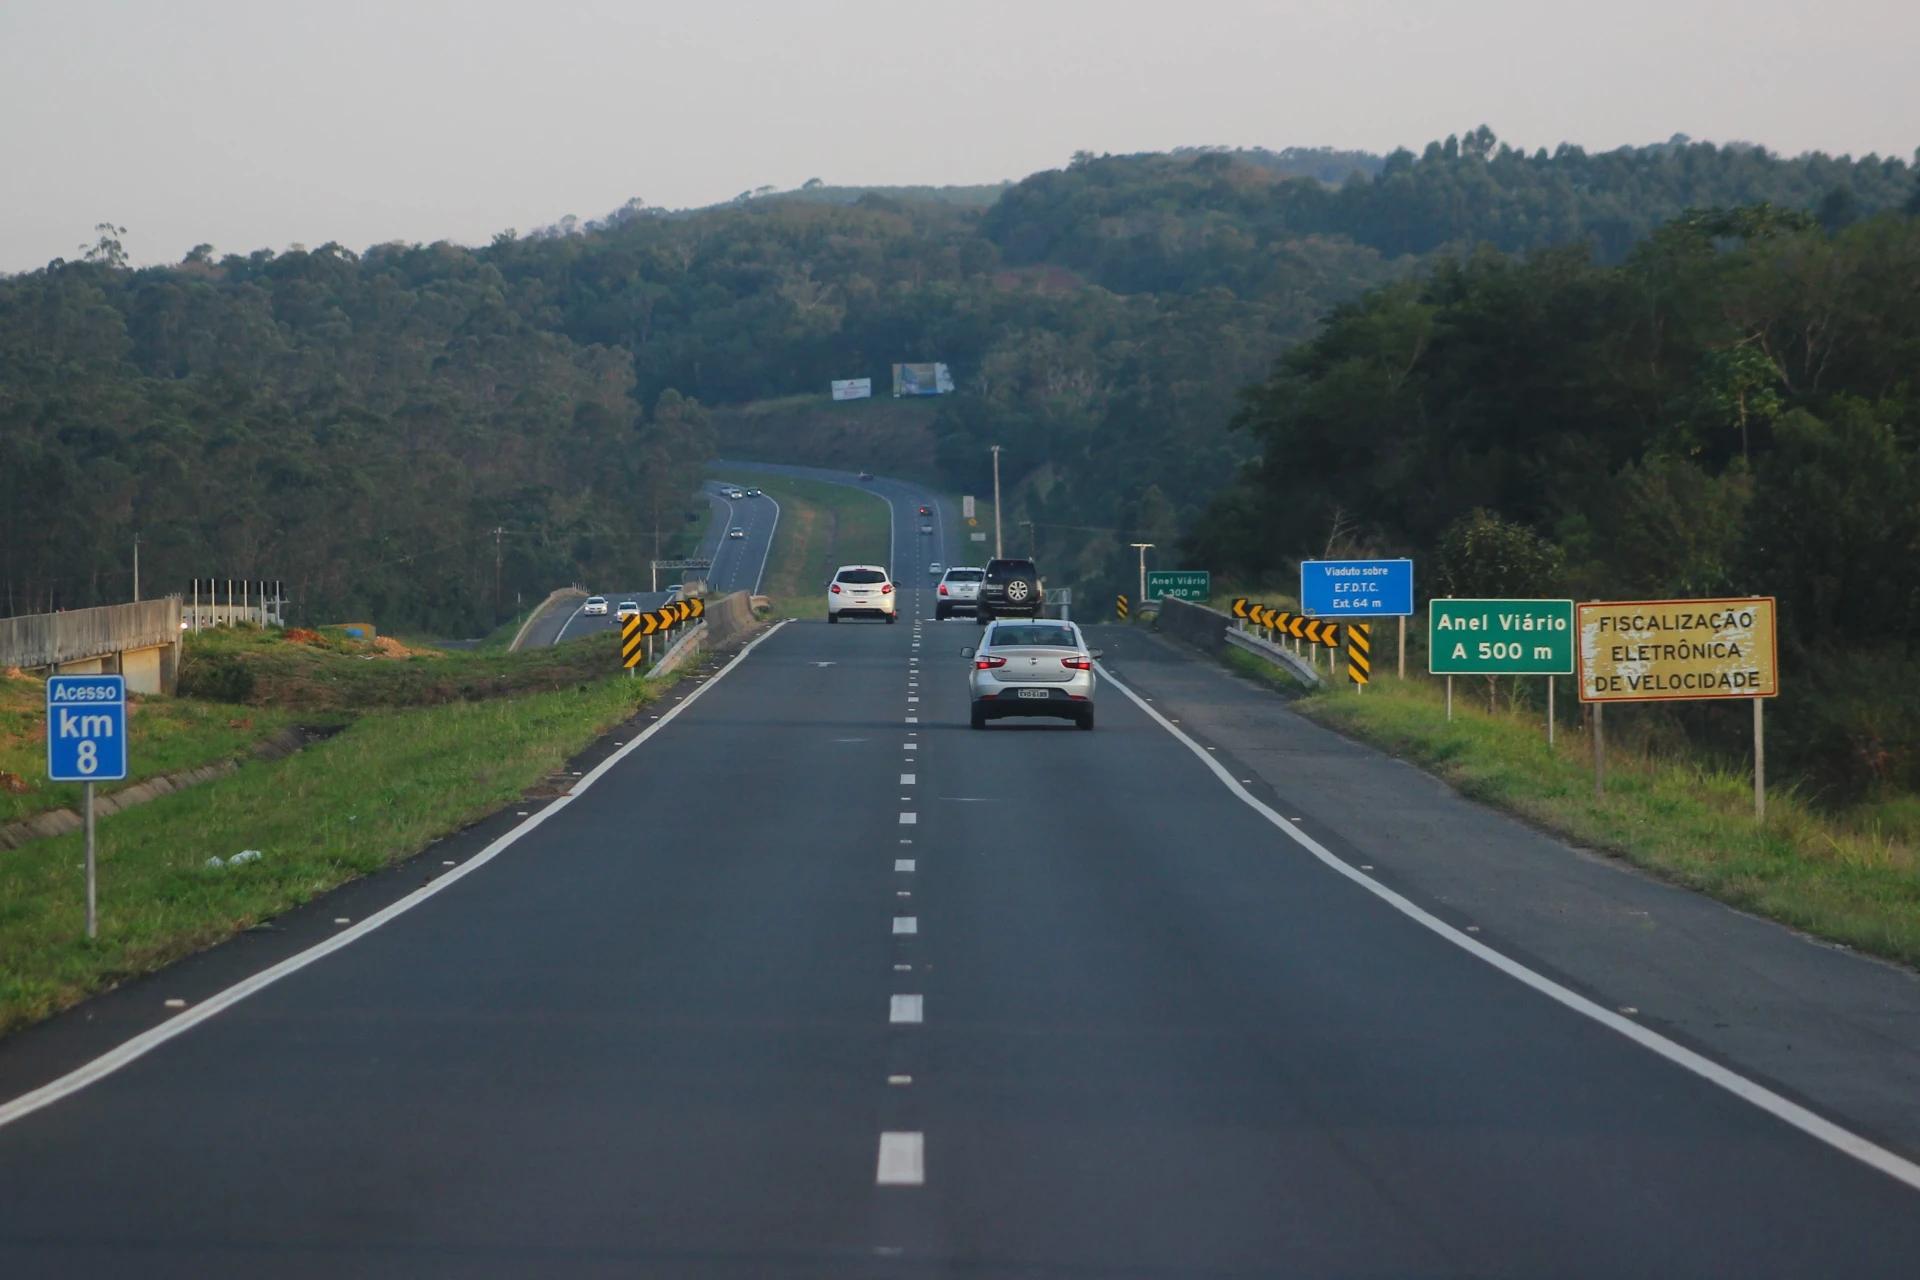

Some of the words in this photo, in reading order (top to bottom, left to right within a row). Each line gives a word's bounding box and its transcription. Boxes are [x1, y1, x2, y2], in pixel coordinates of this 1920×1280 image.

[1324, 567, 1361, 576] Viaduto
[1362, 566, 1389, 575] sobre
[1352, 598, 1368, 608] 64
[1372, 600, 1381, 608] m
[1437, 613, 1488, 631] Anel
[1498, 613, 1567, 631] Viário
[1599, 608, 1753, 633] FISCALIZAÇÃO
[1452, 643, 1468, 660] A
[1478, 642, 1523, 660] 500
[1534, 646, 1552, 660] m
[1611, 639, 1742, 662] ELETRÔNICA
[54, 683, 117, 701] Acesso
[1595, 676, 1622, 693] DE
[1627, 671, 1761, 691] VELOCIDADE
[60, 708, 113, 738] km
[77, 740, 98, 774] 8
